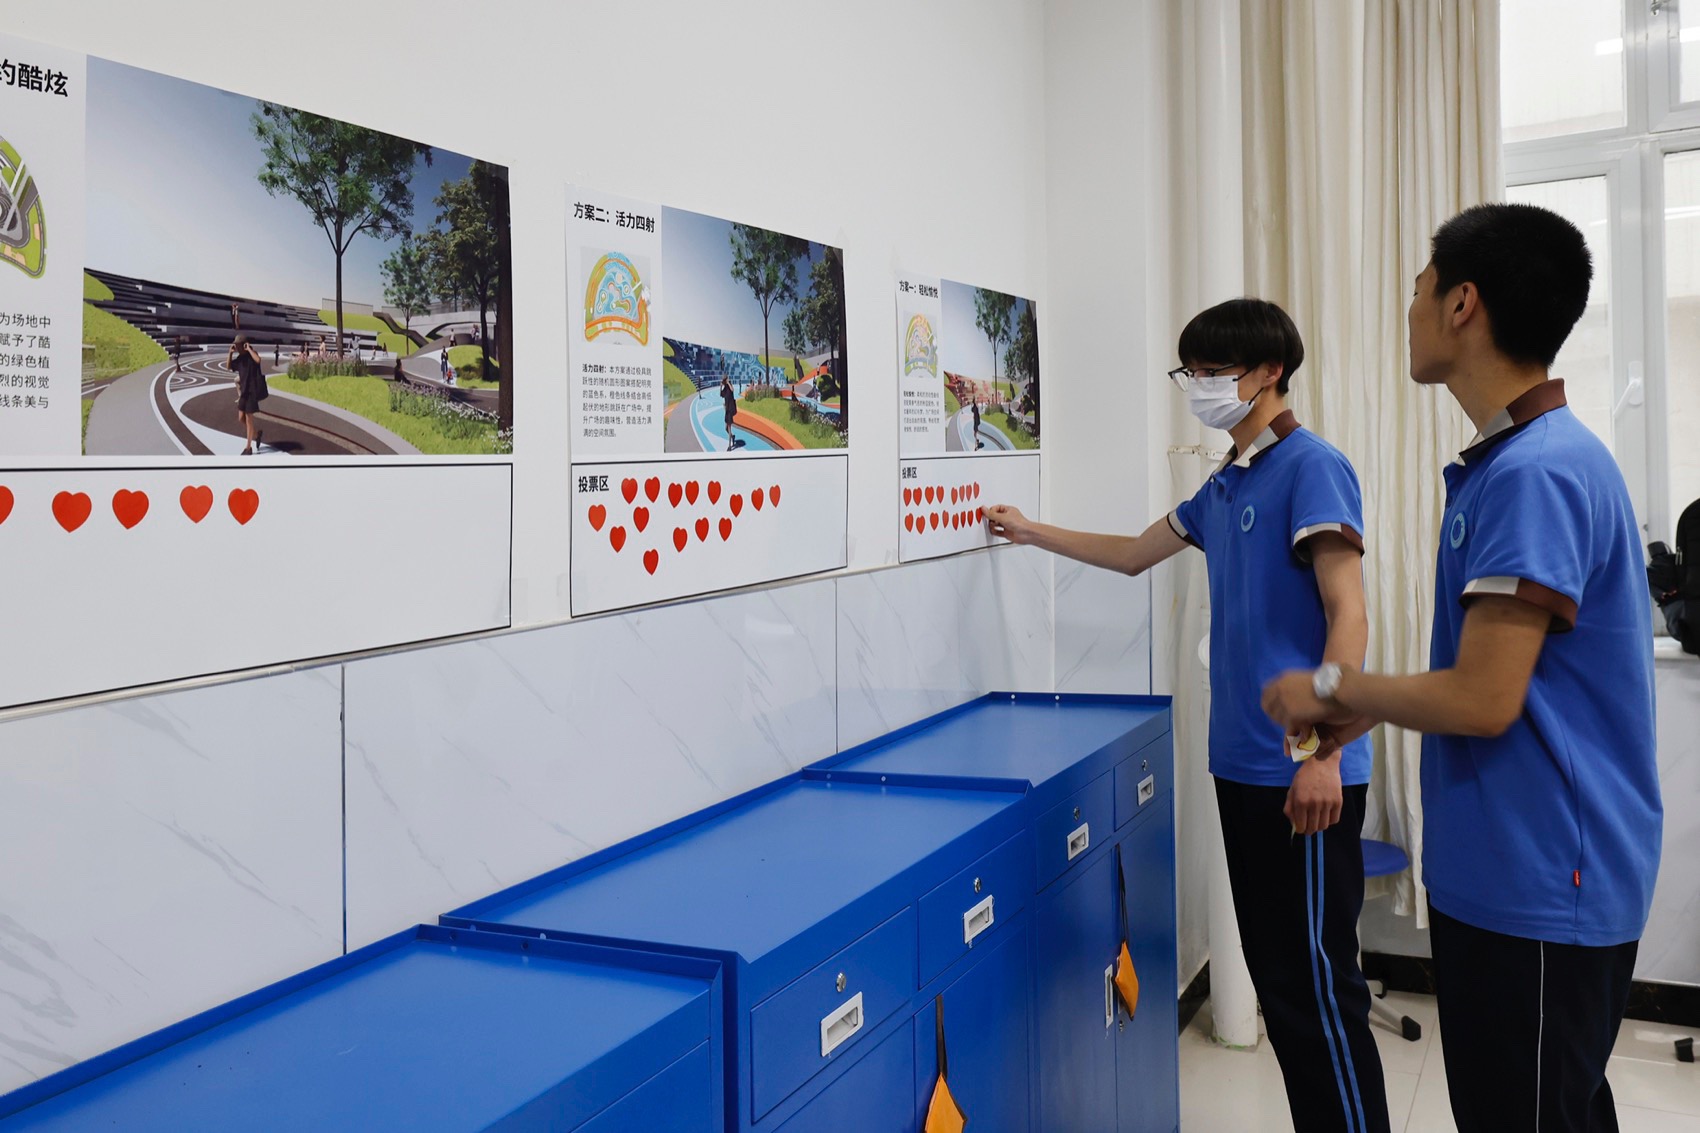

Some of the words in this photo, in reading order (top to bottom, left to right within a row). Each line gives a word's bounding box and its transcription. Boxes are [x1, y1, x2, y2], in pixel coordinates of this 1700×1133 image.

[574, 201, 655, 233] 方案二：活力四射
[0, 312, 51, 328] 为场地中
[0, 353, 50, 369] 的绿色植
[578, 475, 610, 493] 投票区
